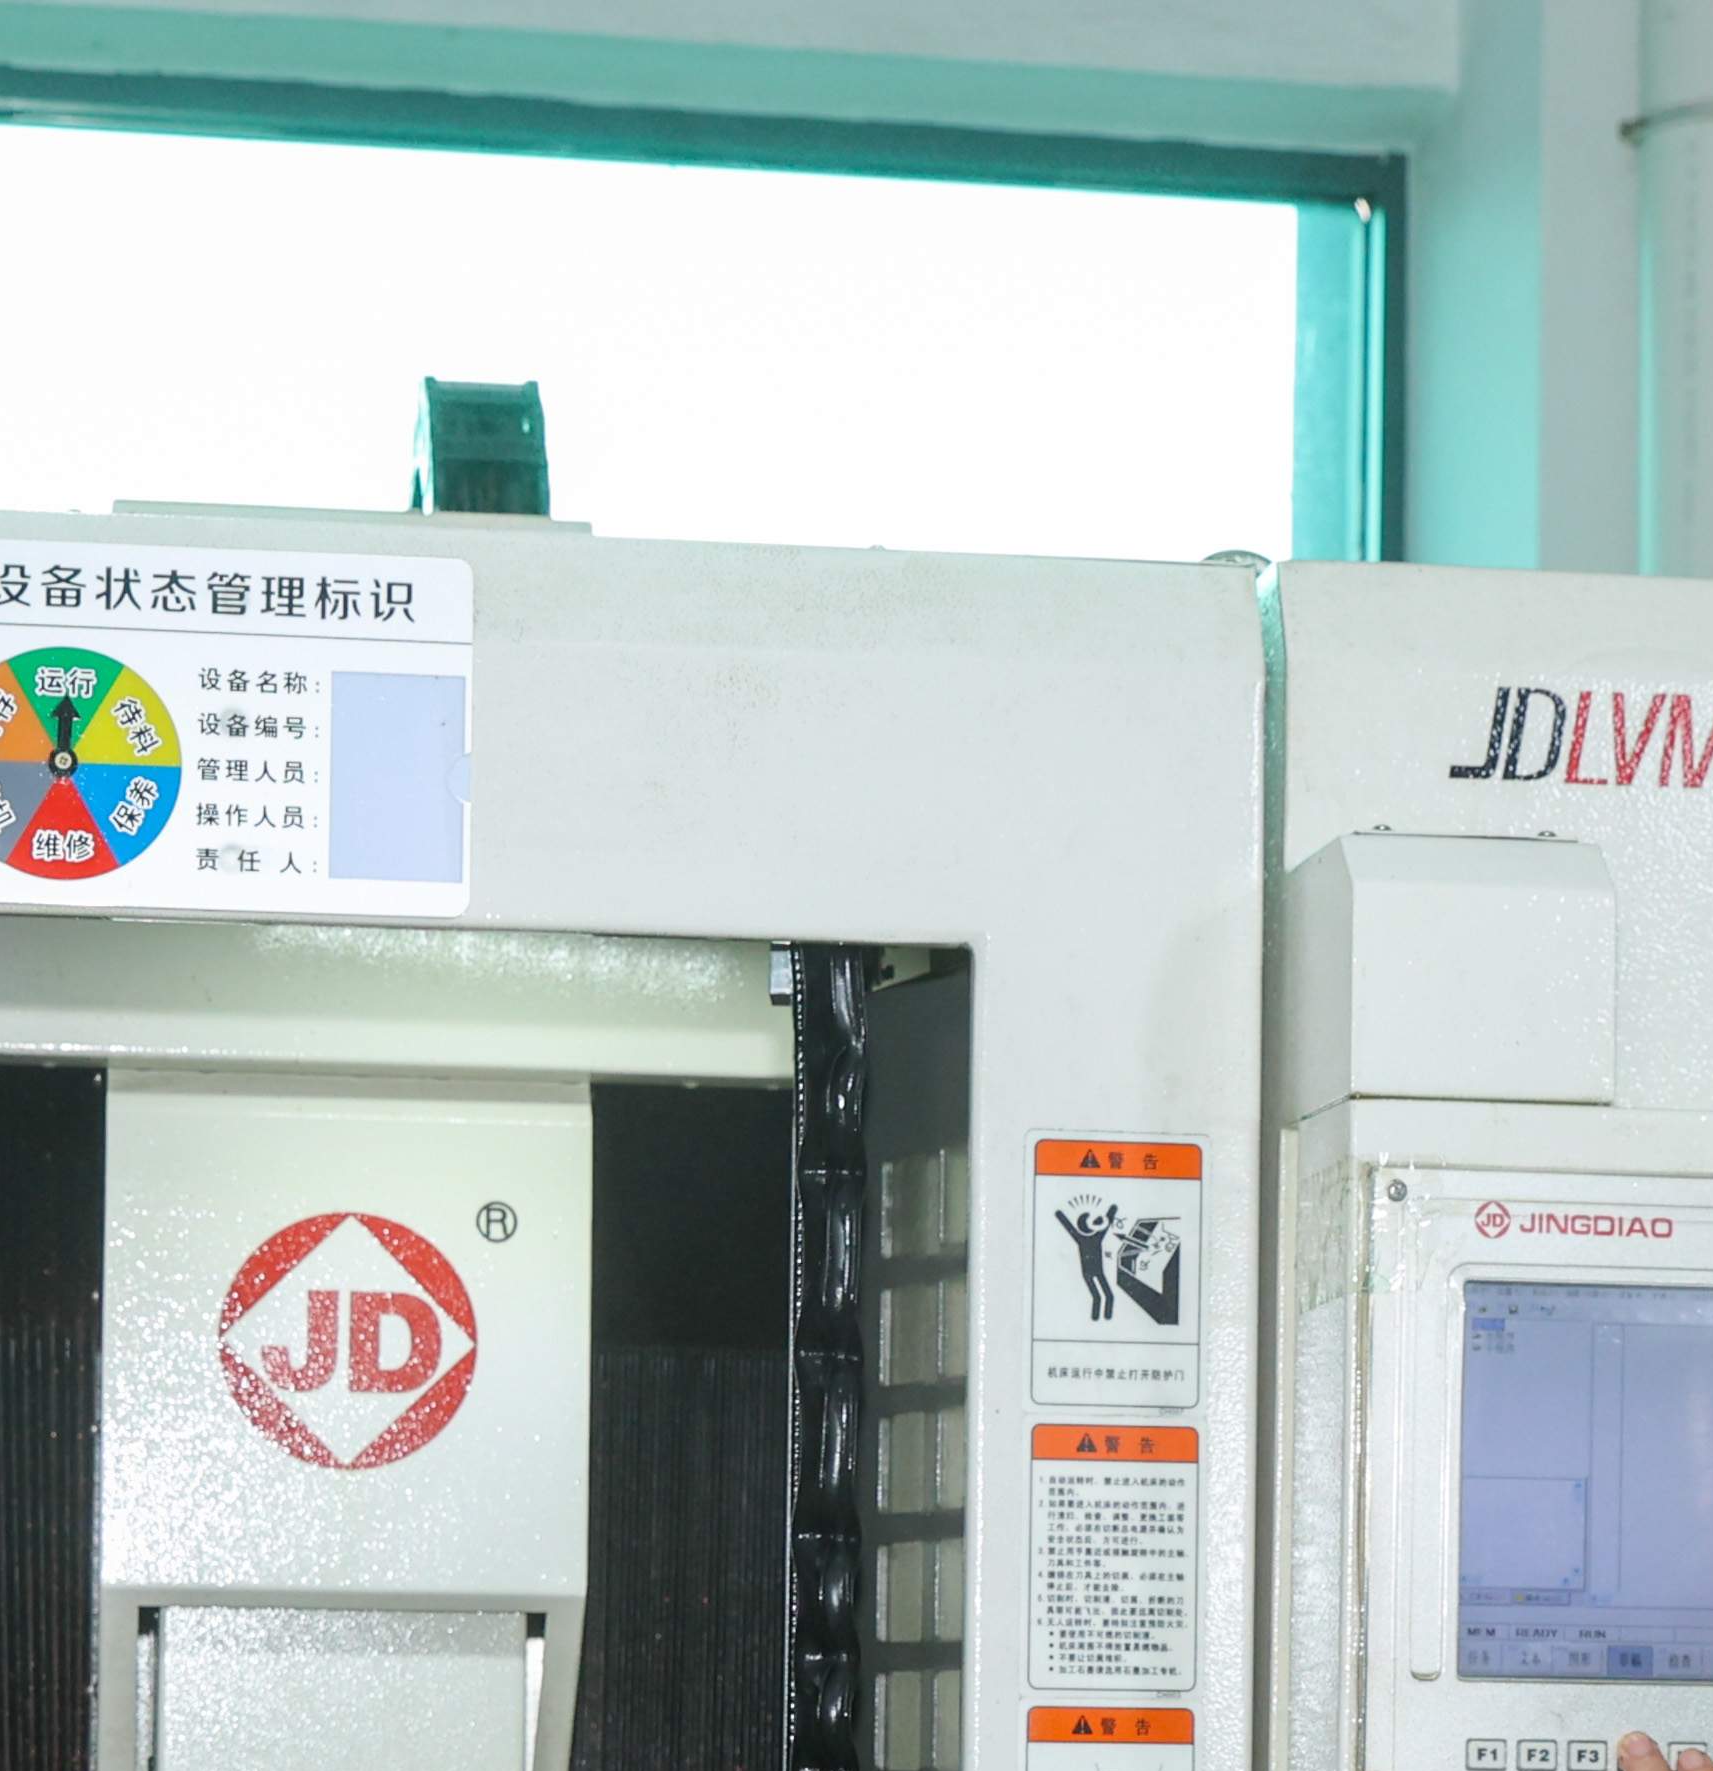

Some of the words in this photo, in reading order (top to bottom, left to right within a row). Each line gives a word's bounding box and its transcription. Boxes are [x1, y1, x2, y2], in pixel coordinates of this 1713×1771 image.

[36, 668, 95, 697] 运行
[113, 698, 161, 756] 待料
[112, 777, 160, 835] 保养
[32, 834, 94, 863] 维修
[1108, 1152, 1158, 1170] 警告
[1481, 1213, 1504, 1228] JD
[1520, 1215, 1674, 1238] JINGDIAO
[261, 1290, 442, 1393] JD
[1105, 1435, 1154, 1453] 警告
[1101, 1718, 1151, 1736] 警告
[1477, 1748, 1497, 1761] F1
[1527, 1749, 1549, 1762] F2
[1577, 1750, 1599, 1764] F3
